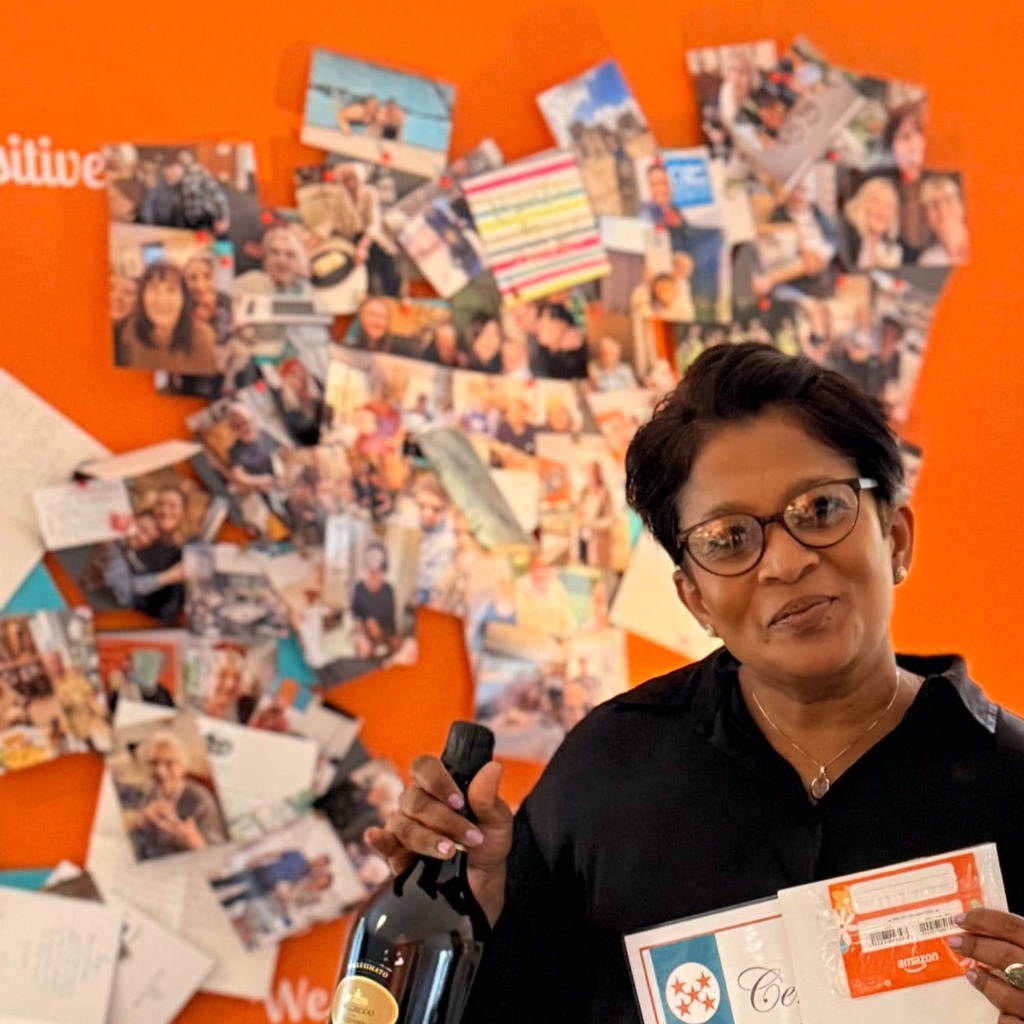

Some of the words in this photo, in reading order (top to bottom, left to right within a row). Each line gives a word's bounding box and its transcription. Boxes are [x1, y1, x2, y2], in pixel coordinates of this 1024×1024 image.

[897, 952, 939, 969] amazon
[262, 976, 330, 1024] We
[737, 966, 800, 1013] Ce
